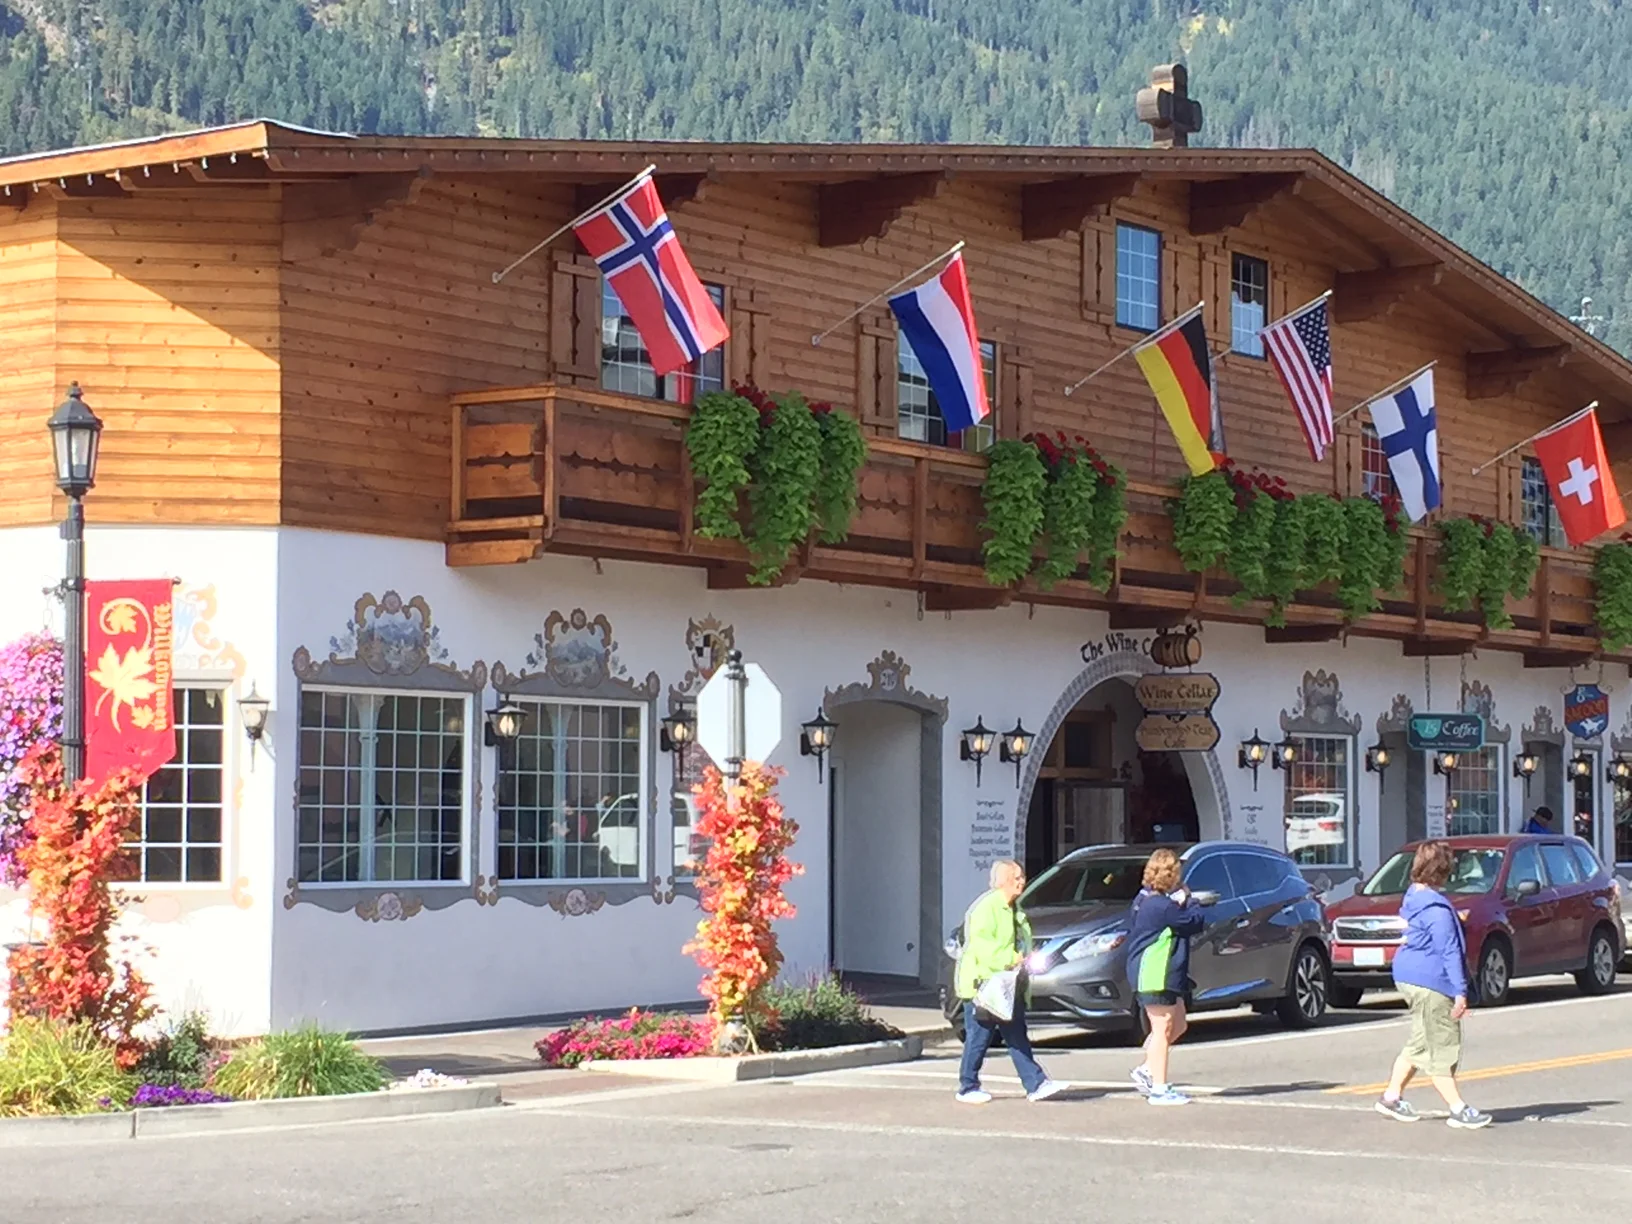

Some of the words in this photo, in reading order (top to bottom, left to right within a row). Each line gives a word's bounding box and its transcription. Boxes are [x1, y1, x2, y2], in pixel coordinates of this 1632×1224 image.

[1080, 640, 1104, 663] The
[1105, 632, 1138, 654] Wine
[153, 602, 173, 731] Willkommen
[1139, 685, 1173, 699] Wine
[1176, 683, 1212, 699] Cellar
[1442, 720, 1479, 739] Coffee
